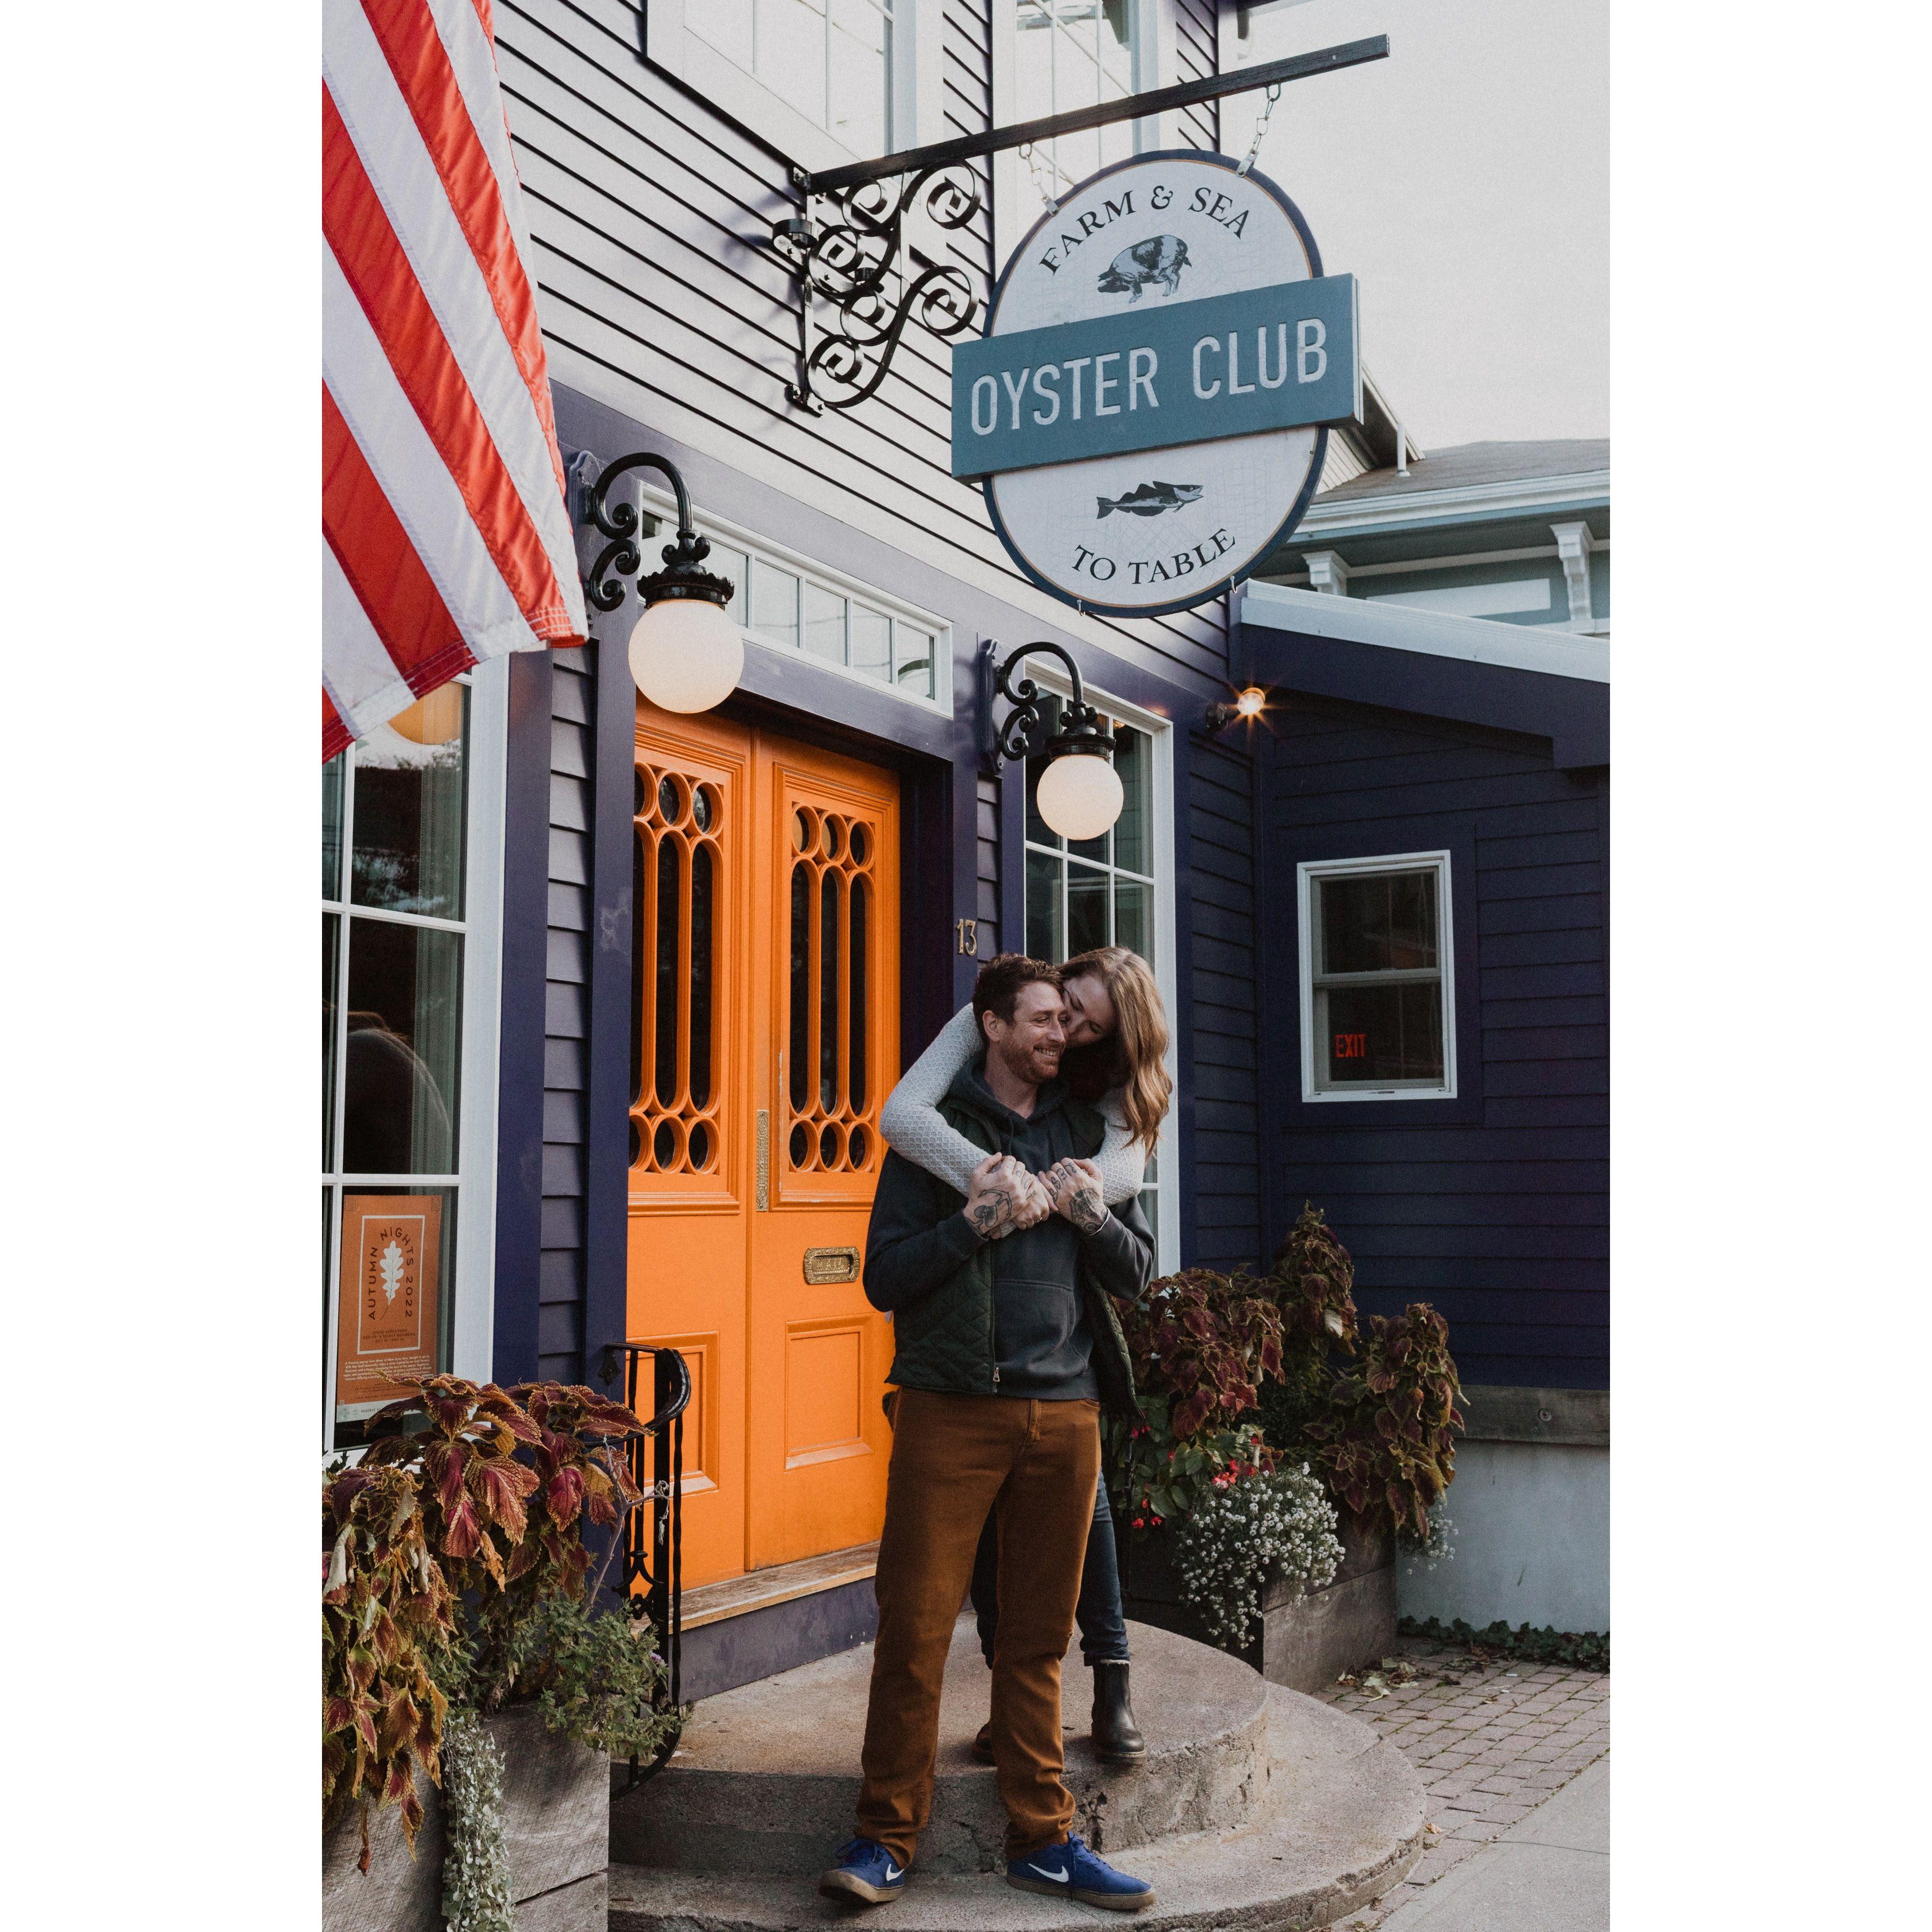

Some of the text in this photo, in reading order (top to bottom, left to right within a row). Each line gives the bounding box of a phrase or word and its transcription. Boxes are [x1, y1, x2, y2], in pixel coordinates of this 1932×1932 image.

[1038, 185, 1250, 276] FARM & SEA
[971, 317, 1327, 436] OYSTER CLUB
[1071, 528, 1236, 585] TO TABLE
[956, 918, 977, 956] 13
[1335, 1034, 1365, 1058] EXIT
[368, 1227, 414, 1320] AUTUMN NIGHTS 2022
[816, 1258, 845, 1271] MAIL
